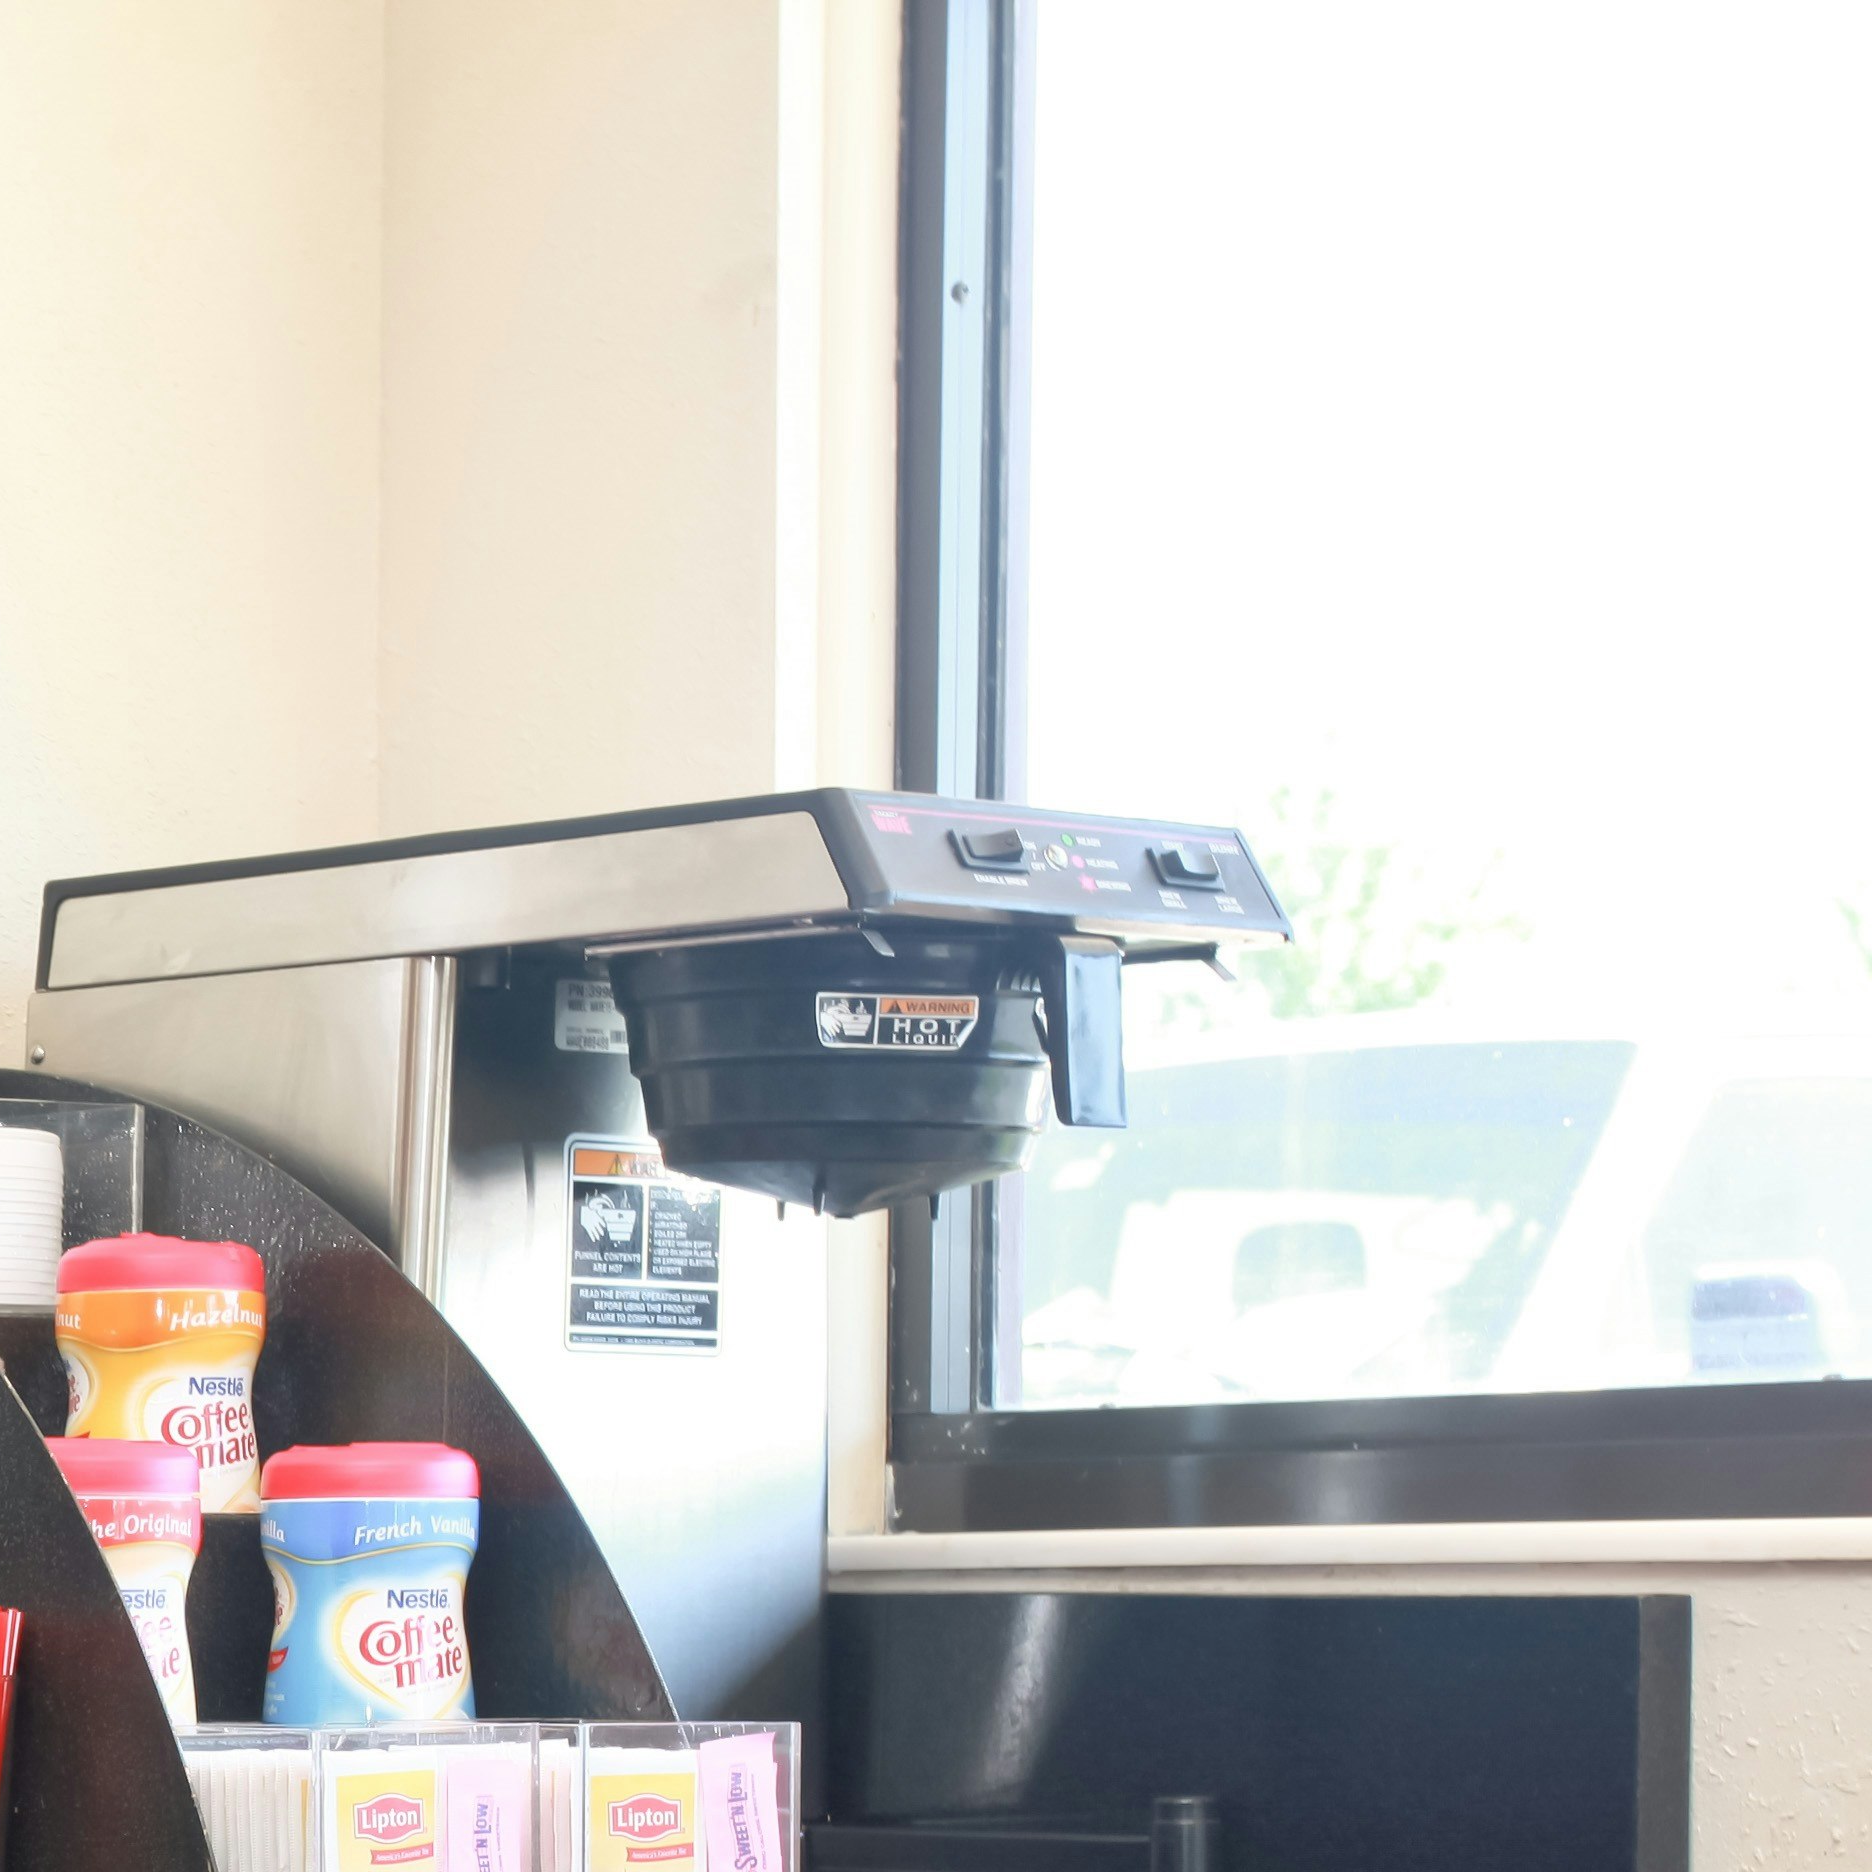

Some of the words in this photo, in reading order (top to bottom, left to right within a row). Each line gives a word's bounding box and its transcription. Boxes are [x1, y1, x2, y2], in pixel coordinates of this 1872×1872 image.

[905, 1002, 971, 1014] WARNING
[893, 1018, 962, 1034] HOT
[195, 1432, 256, 1469] mate
[90, 1518, 116, 1539] he
[123, 1513, 193, 1538] Original
[354, 1515, 423, 1546] French
[430, 1514, 476, 1542] Vanilla
[393, 1645, 463, 1688] mate
[360, 1807, 419, 1834] Lipton
[616, 1806, 676, 1833] Lipton
